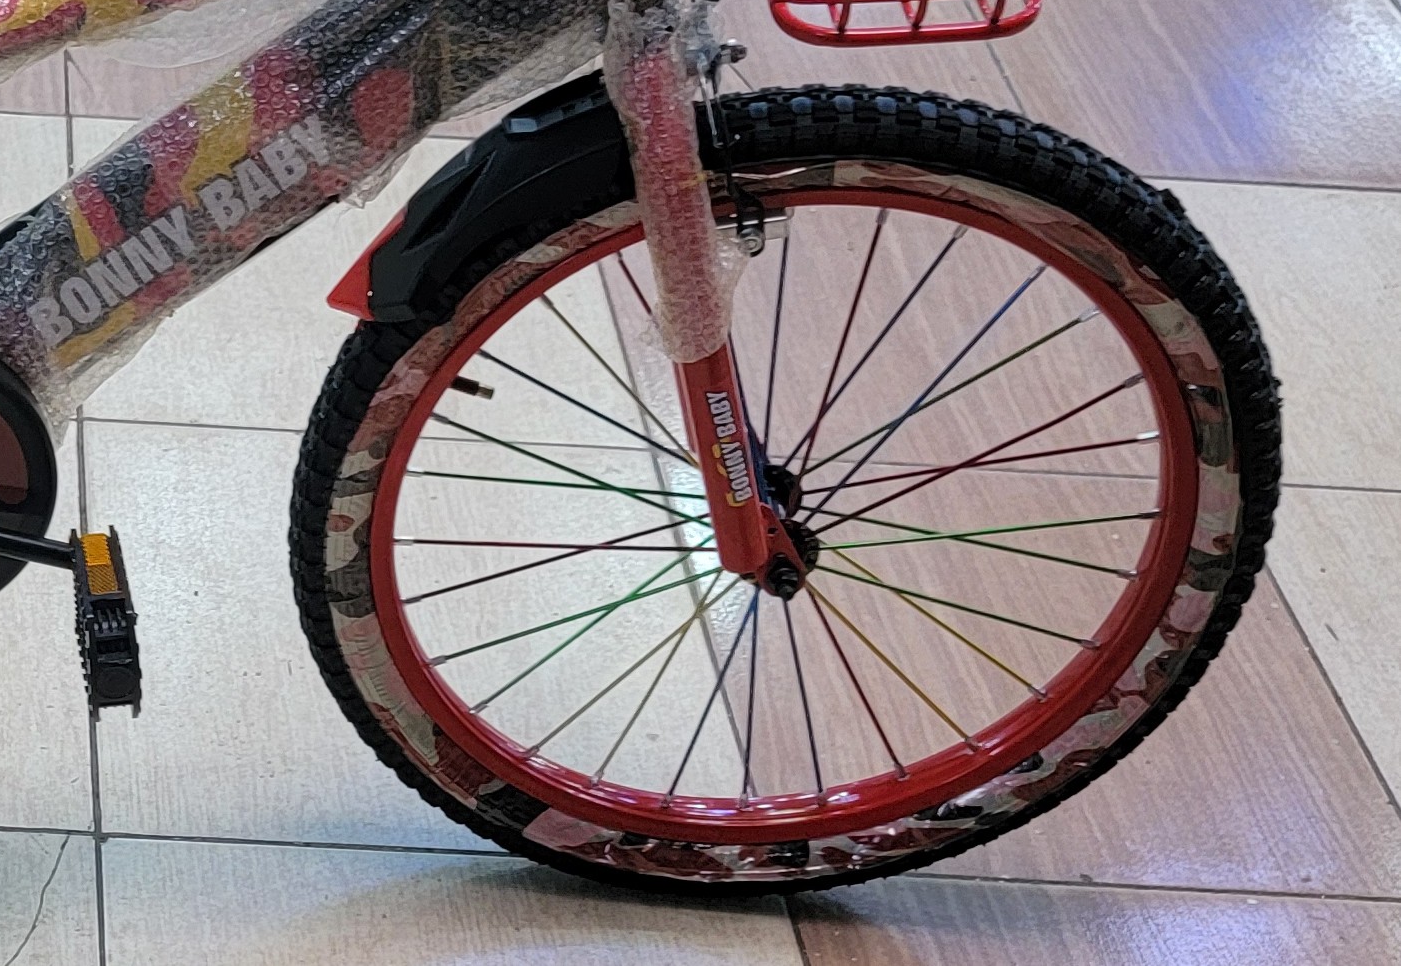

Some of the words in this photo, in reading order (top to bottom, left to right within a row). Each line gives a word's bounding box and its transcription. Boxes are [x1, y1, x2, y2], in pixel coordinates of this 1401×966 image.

[27, 205, 197, 347] BONNY
[199, 117, 332, 231] BABY
[706, 392, 737, 437] BABY
[721, 441, 752, 501] BONNY
